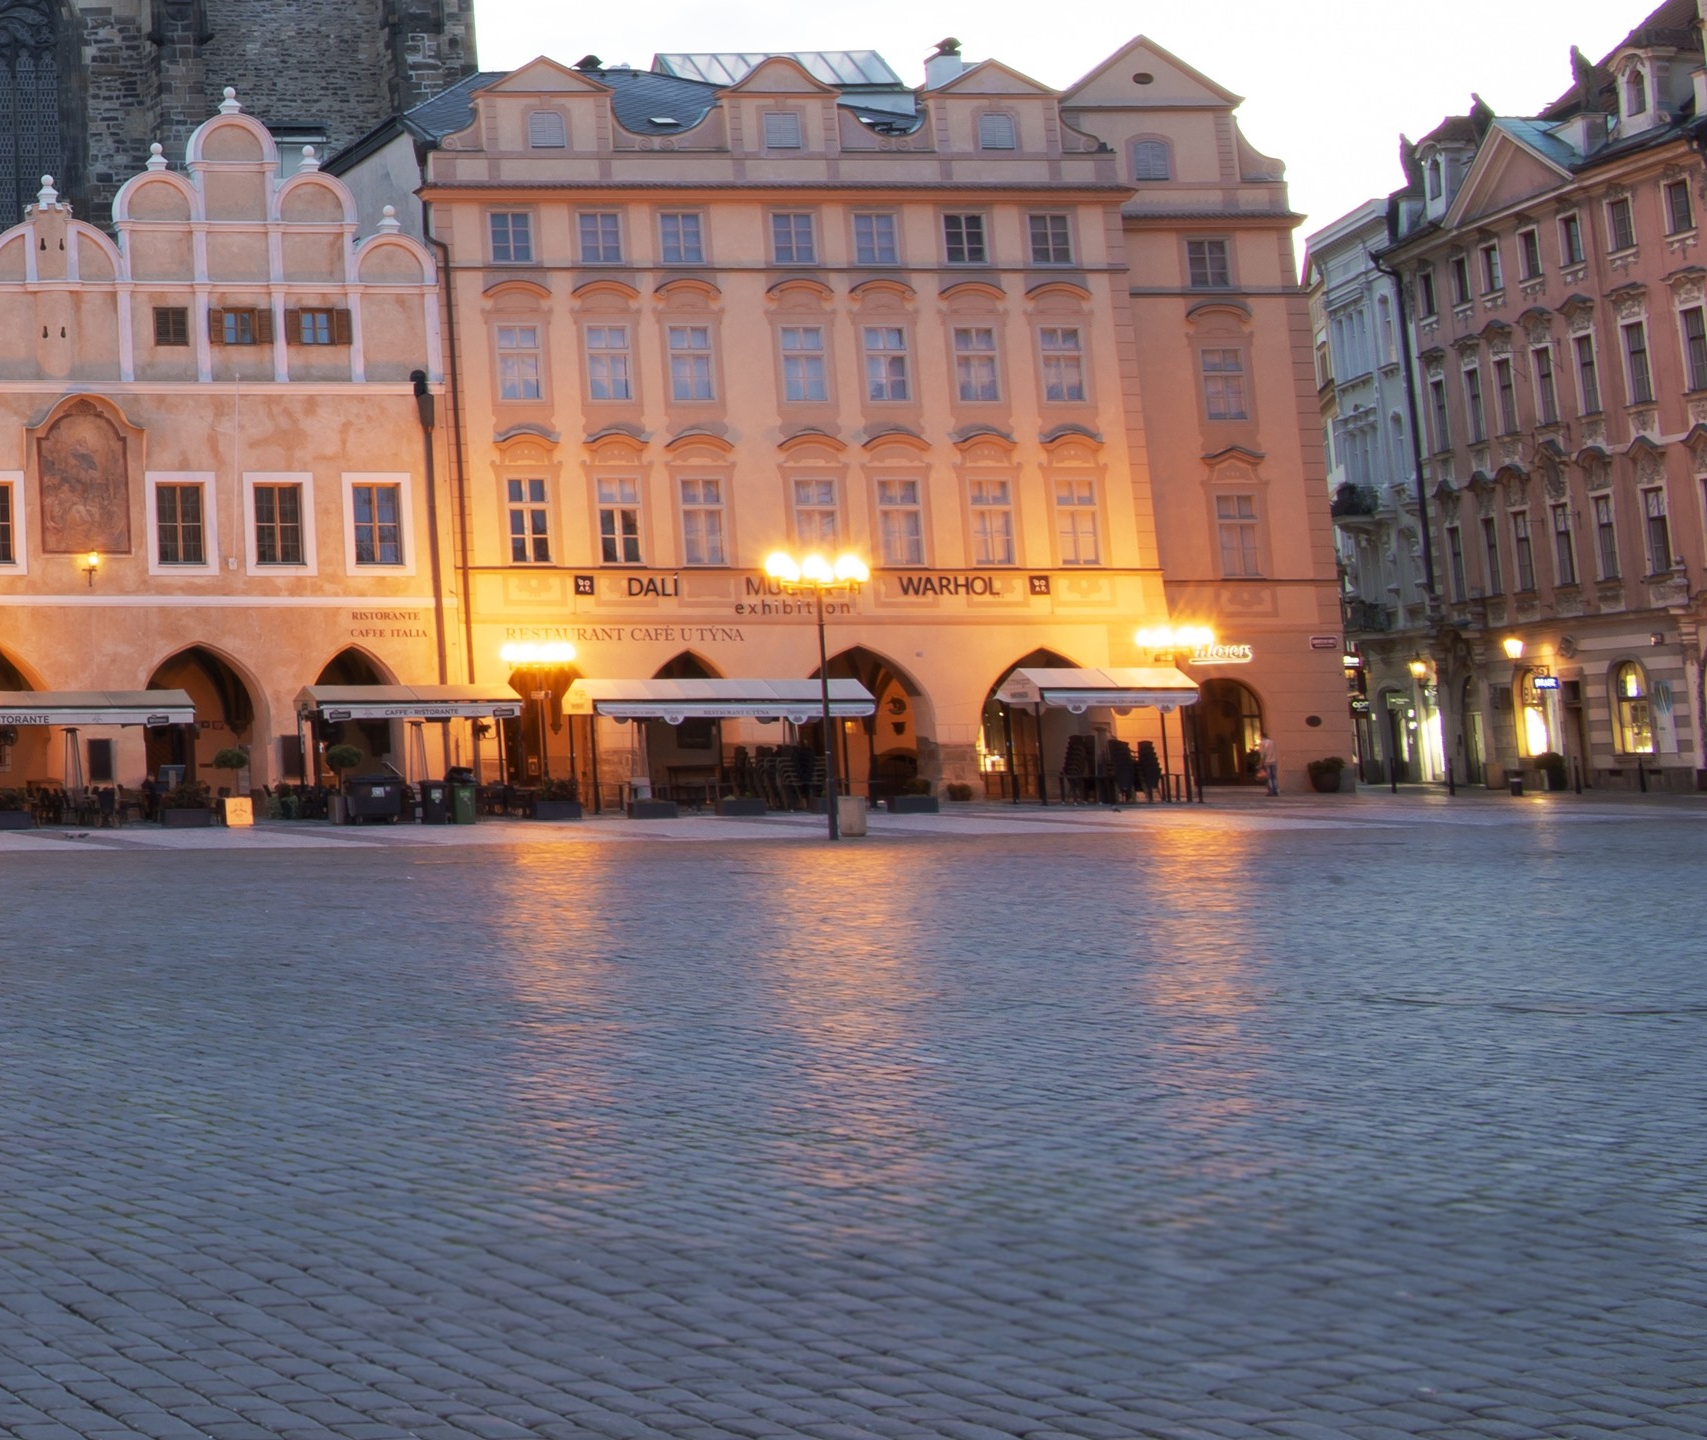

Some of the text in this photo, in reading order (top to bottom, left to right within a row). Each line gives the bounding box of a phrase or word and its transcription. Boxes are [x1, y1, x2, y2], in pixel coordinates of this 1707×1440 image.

[628, 573, 1000, 597] DALÍ WARHOL
[735, 599, 851, 615] exhibiton
[352, 611, 420, 621] RISTORANTE
[350, 629, 428, 638] CAFFE ITALIA
[506, 627, 625, 642] RESTAURANT
[681, 628, 692, 642] U
[696, 624, 745, 642] TÝNA
